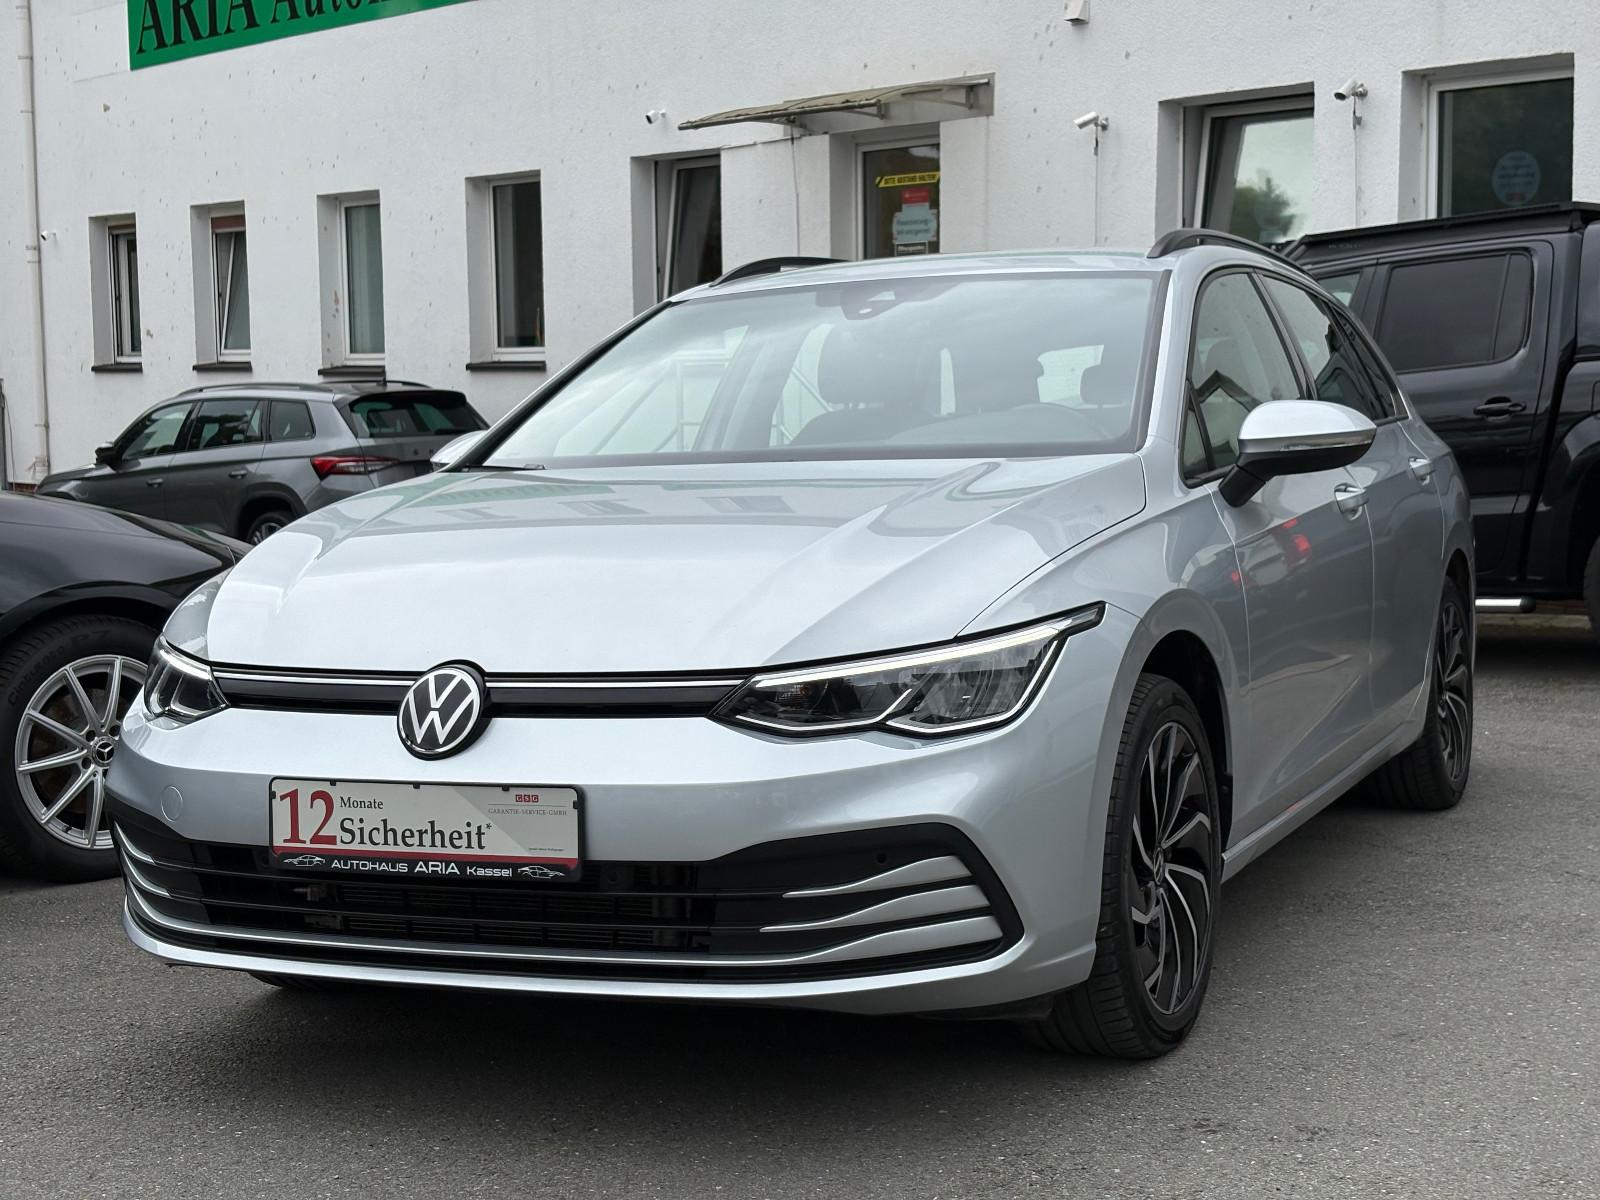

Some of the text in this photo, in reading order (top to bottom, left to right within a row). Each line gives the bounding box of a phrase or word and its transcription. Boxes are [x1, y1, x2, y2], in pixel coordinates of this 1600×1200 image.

[340, 796, 384, 810] Monate
[279, 788, 337, 846] 12
[331, 859, 512, 877] AUTOHAUS ARIA Kassel
